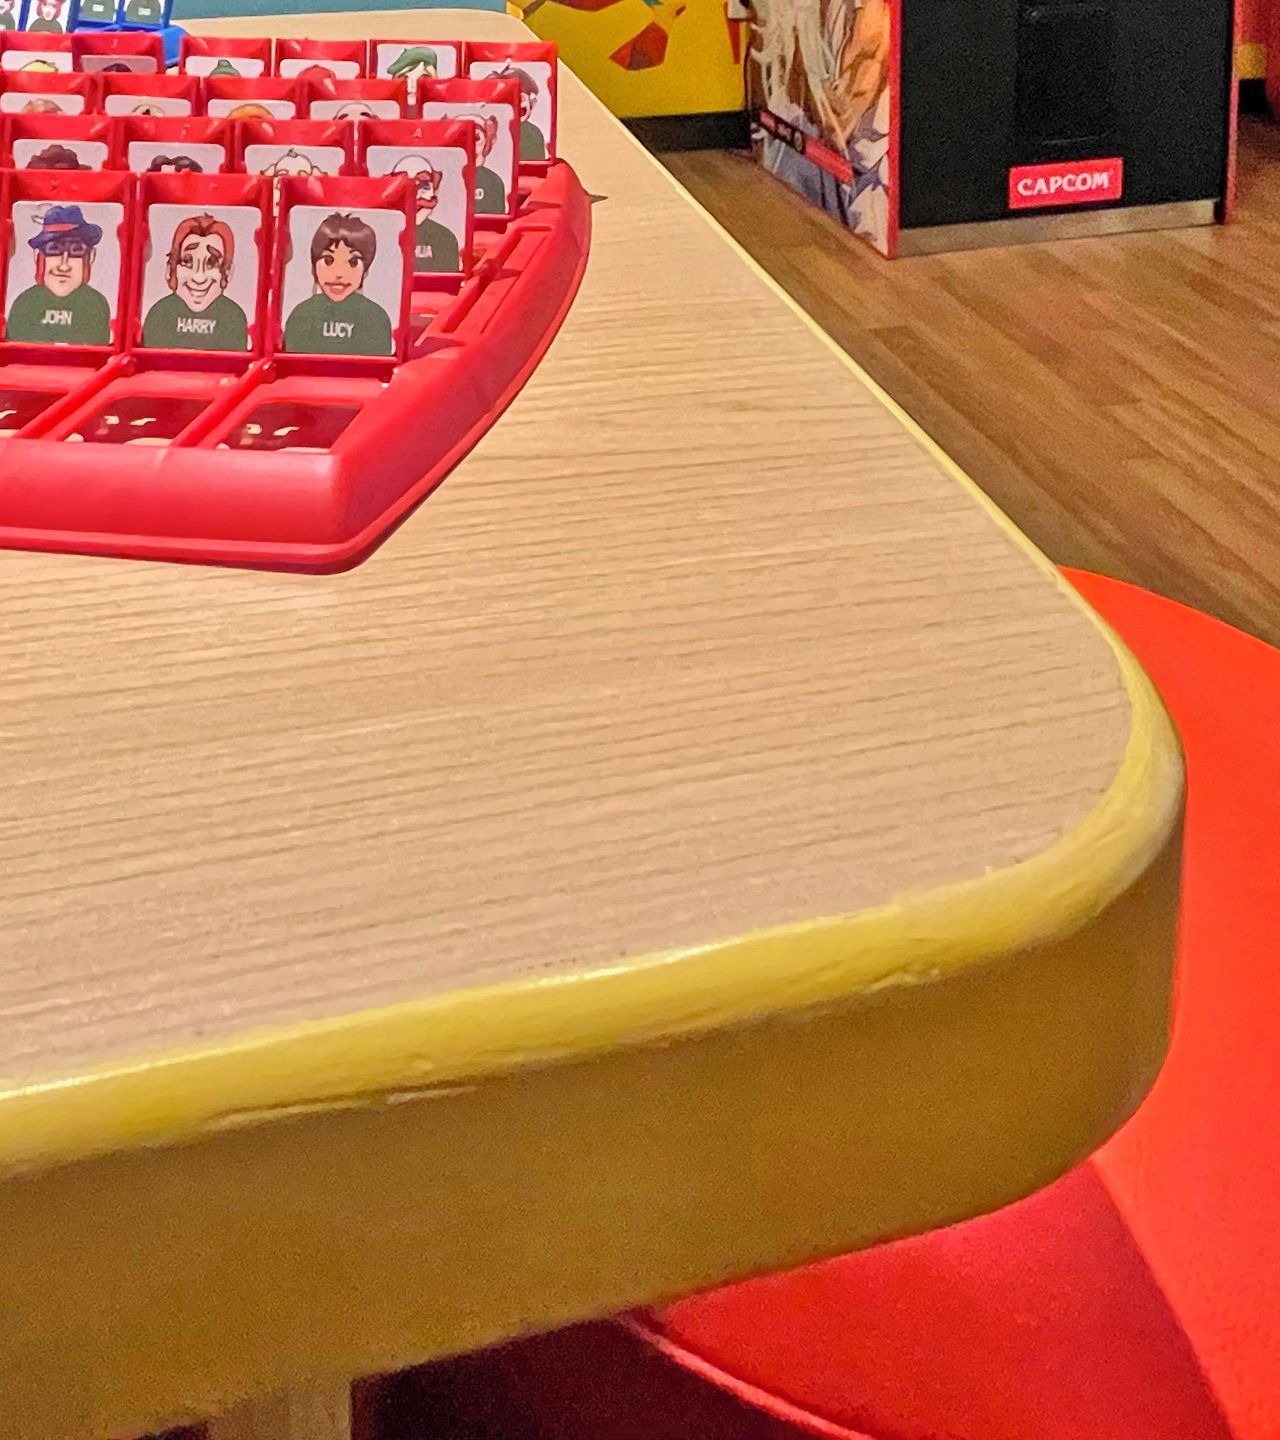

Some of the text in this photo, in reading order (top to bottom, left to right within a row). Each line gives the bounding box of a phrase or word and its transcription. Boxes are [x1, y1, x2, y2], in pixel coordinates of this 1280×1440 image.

[1017, 171, 1110, 196] CAPCOM
[41, 309, 73, 326] JOHN
[176, 316, 217, 336] HARRY
[323, 321, 355, 338] LUCY
